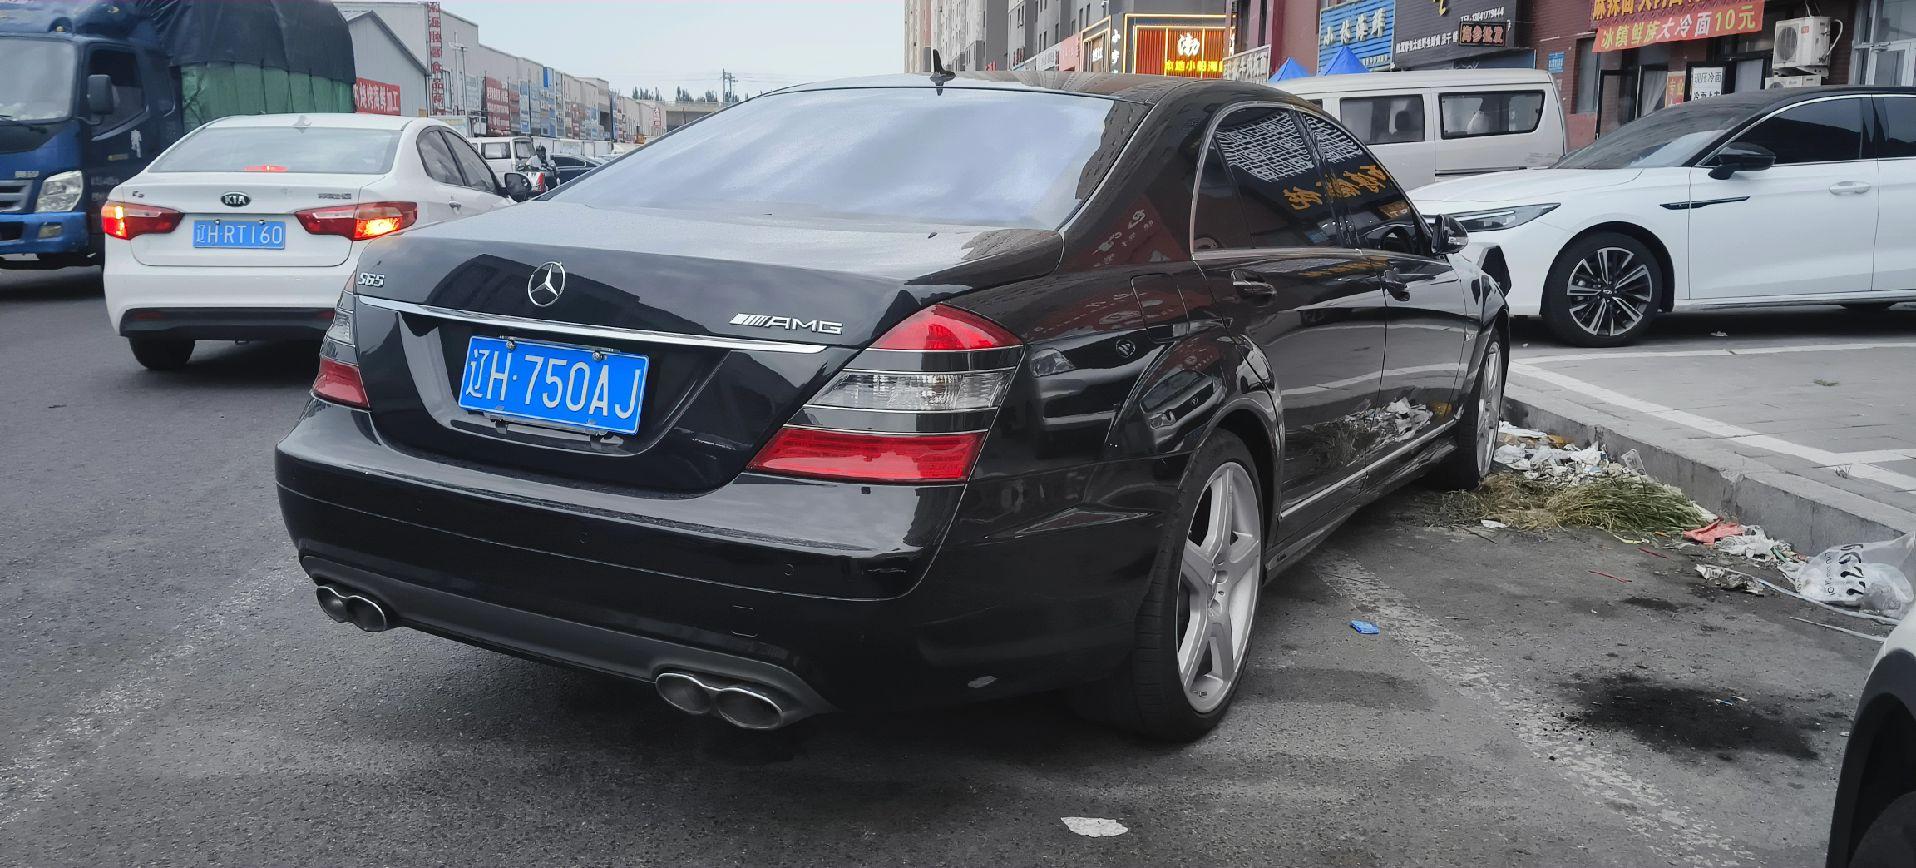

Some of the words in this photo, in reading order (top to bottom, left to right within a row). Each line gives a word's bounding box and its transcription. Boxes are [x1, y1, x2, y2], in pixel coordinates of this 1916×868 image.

[223, 195, 248, 205] KIA
[358, 272, 385, 288] S65
[764, 315, 843, 335] AMG
